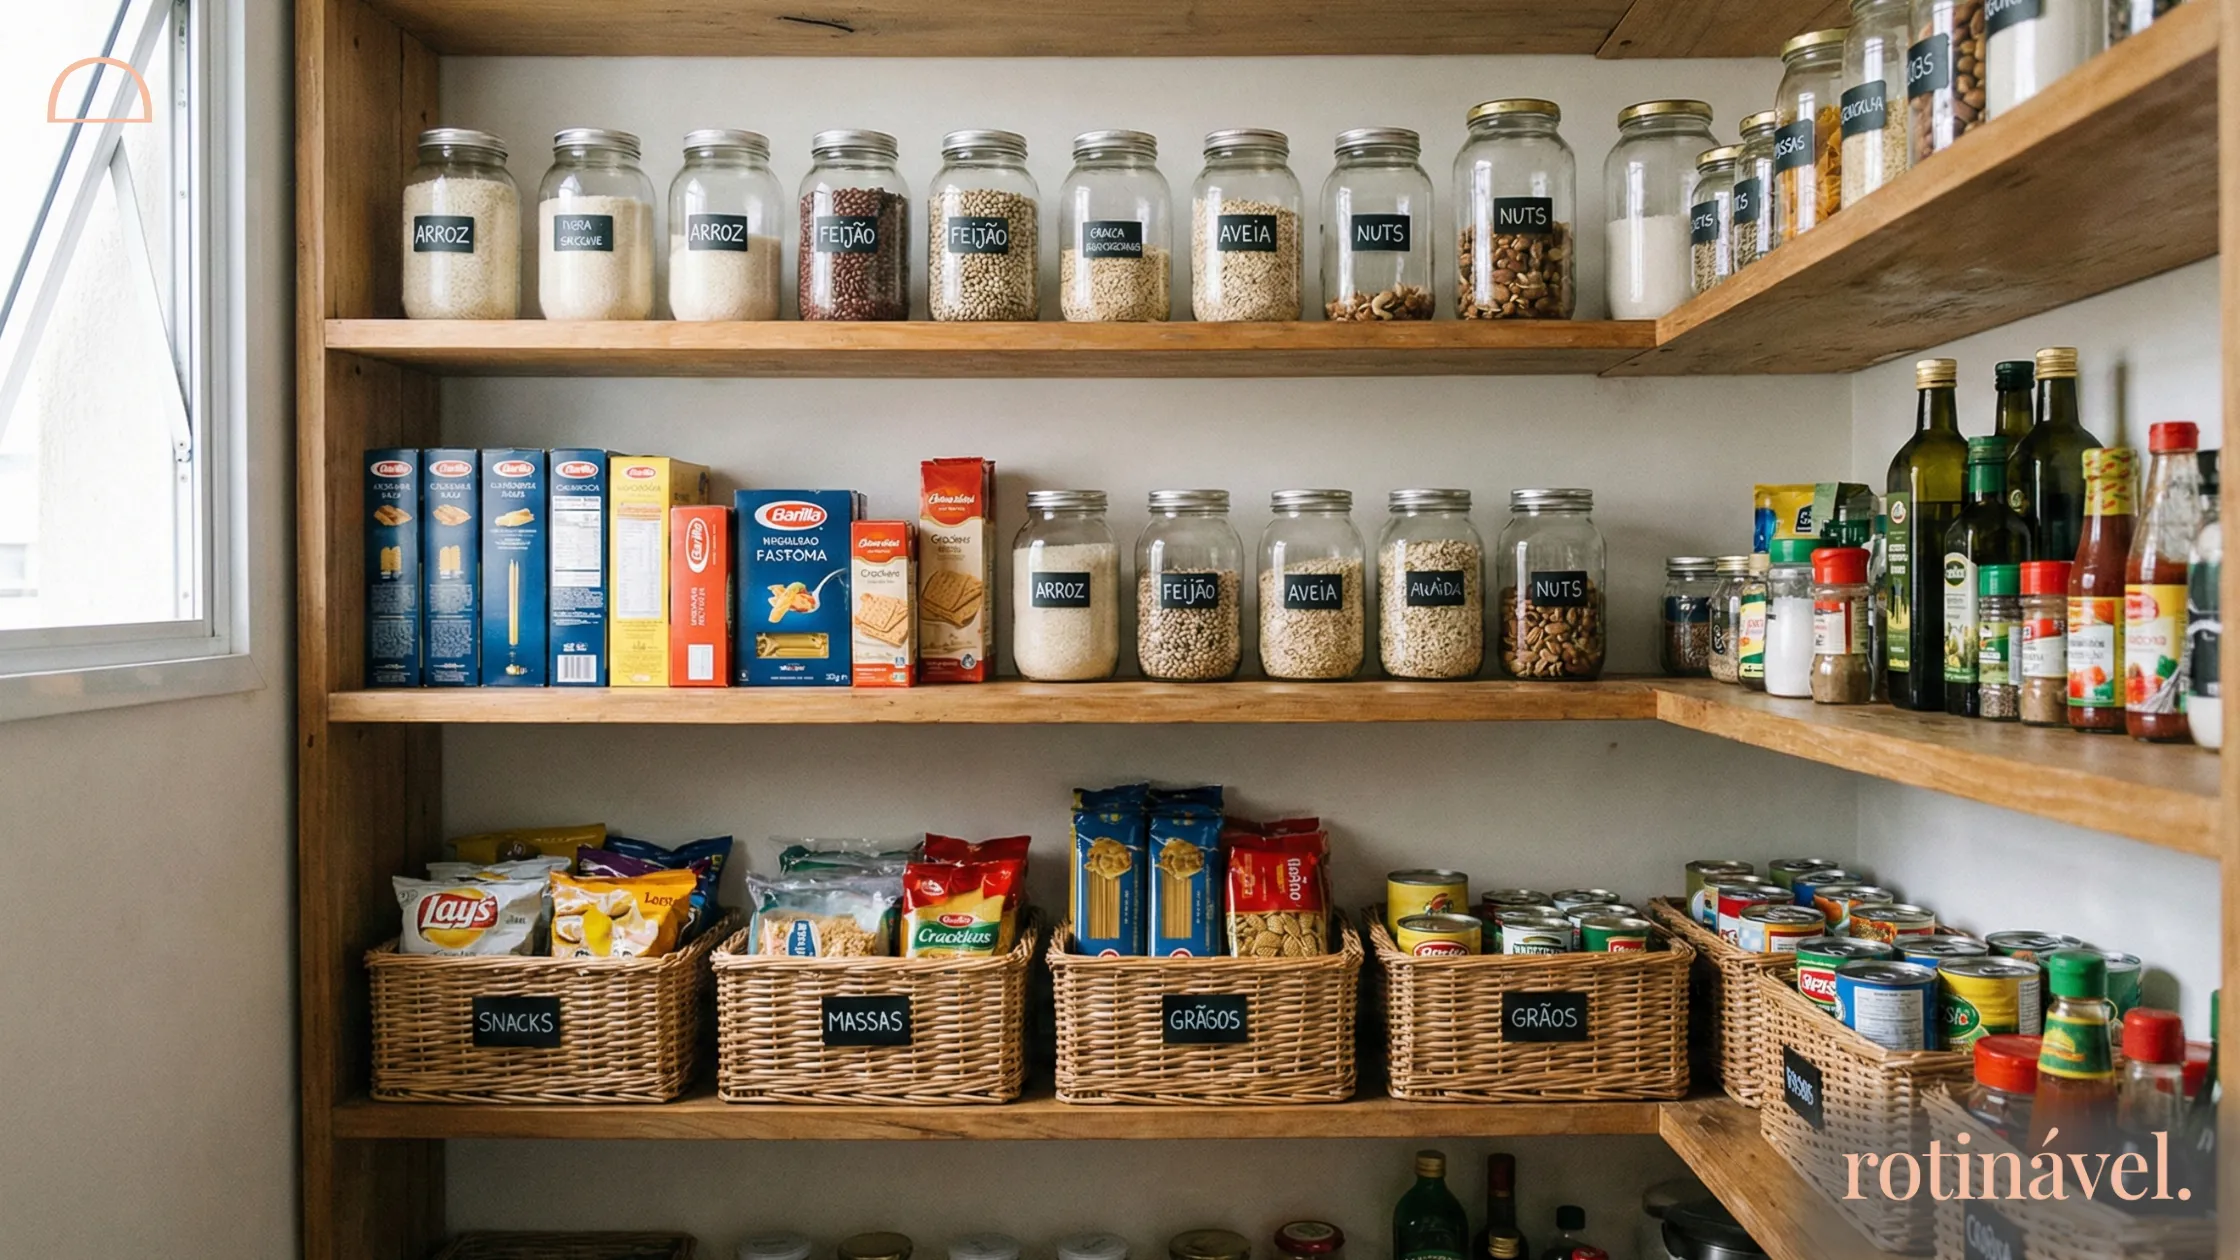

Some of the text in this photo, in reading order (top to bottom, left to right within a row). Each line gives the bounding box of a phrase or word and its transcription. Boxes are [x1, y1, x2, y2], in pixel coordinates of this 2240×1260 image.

[1500, 207, 1547, 225] NUTS
[415, 225, 470, 244] ARROZ
[690, 223, 744, 242] ARROZ
[1357, 224, 1404, 243] NUTS
[1035, 582, 1085, 599] ARROZ
[1537, 580, 1582, 598] NUTS
[420, 894, 495, 930] Lay's
[479, 1011, 554, 1033] SNACKS
[828, 1011, 903, 1032] MASSAS
[1511, 1002, 1578, 1028] GRÃOS
